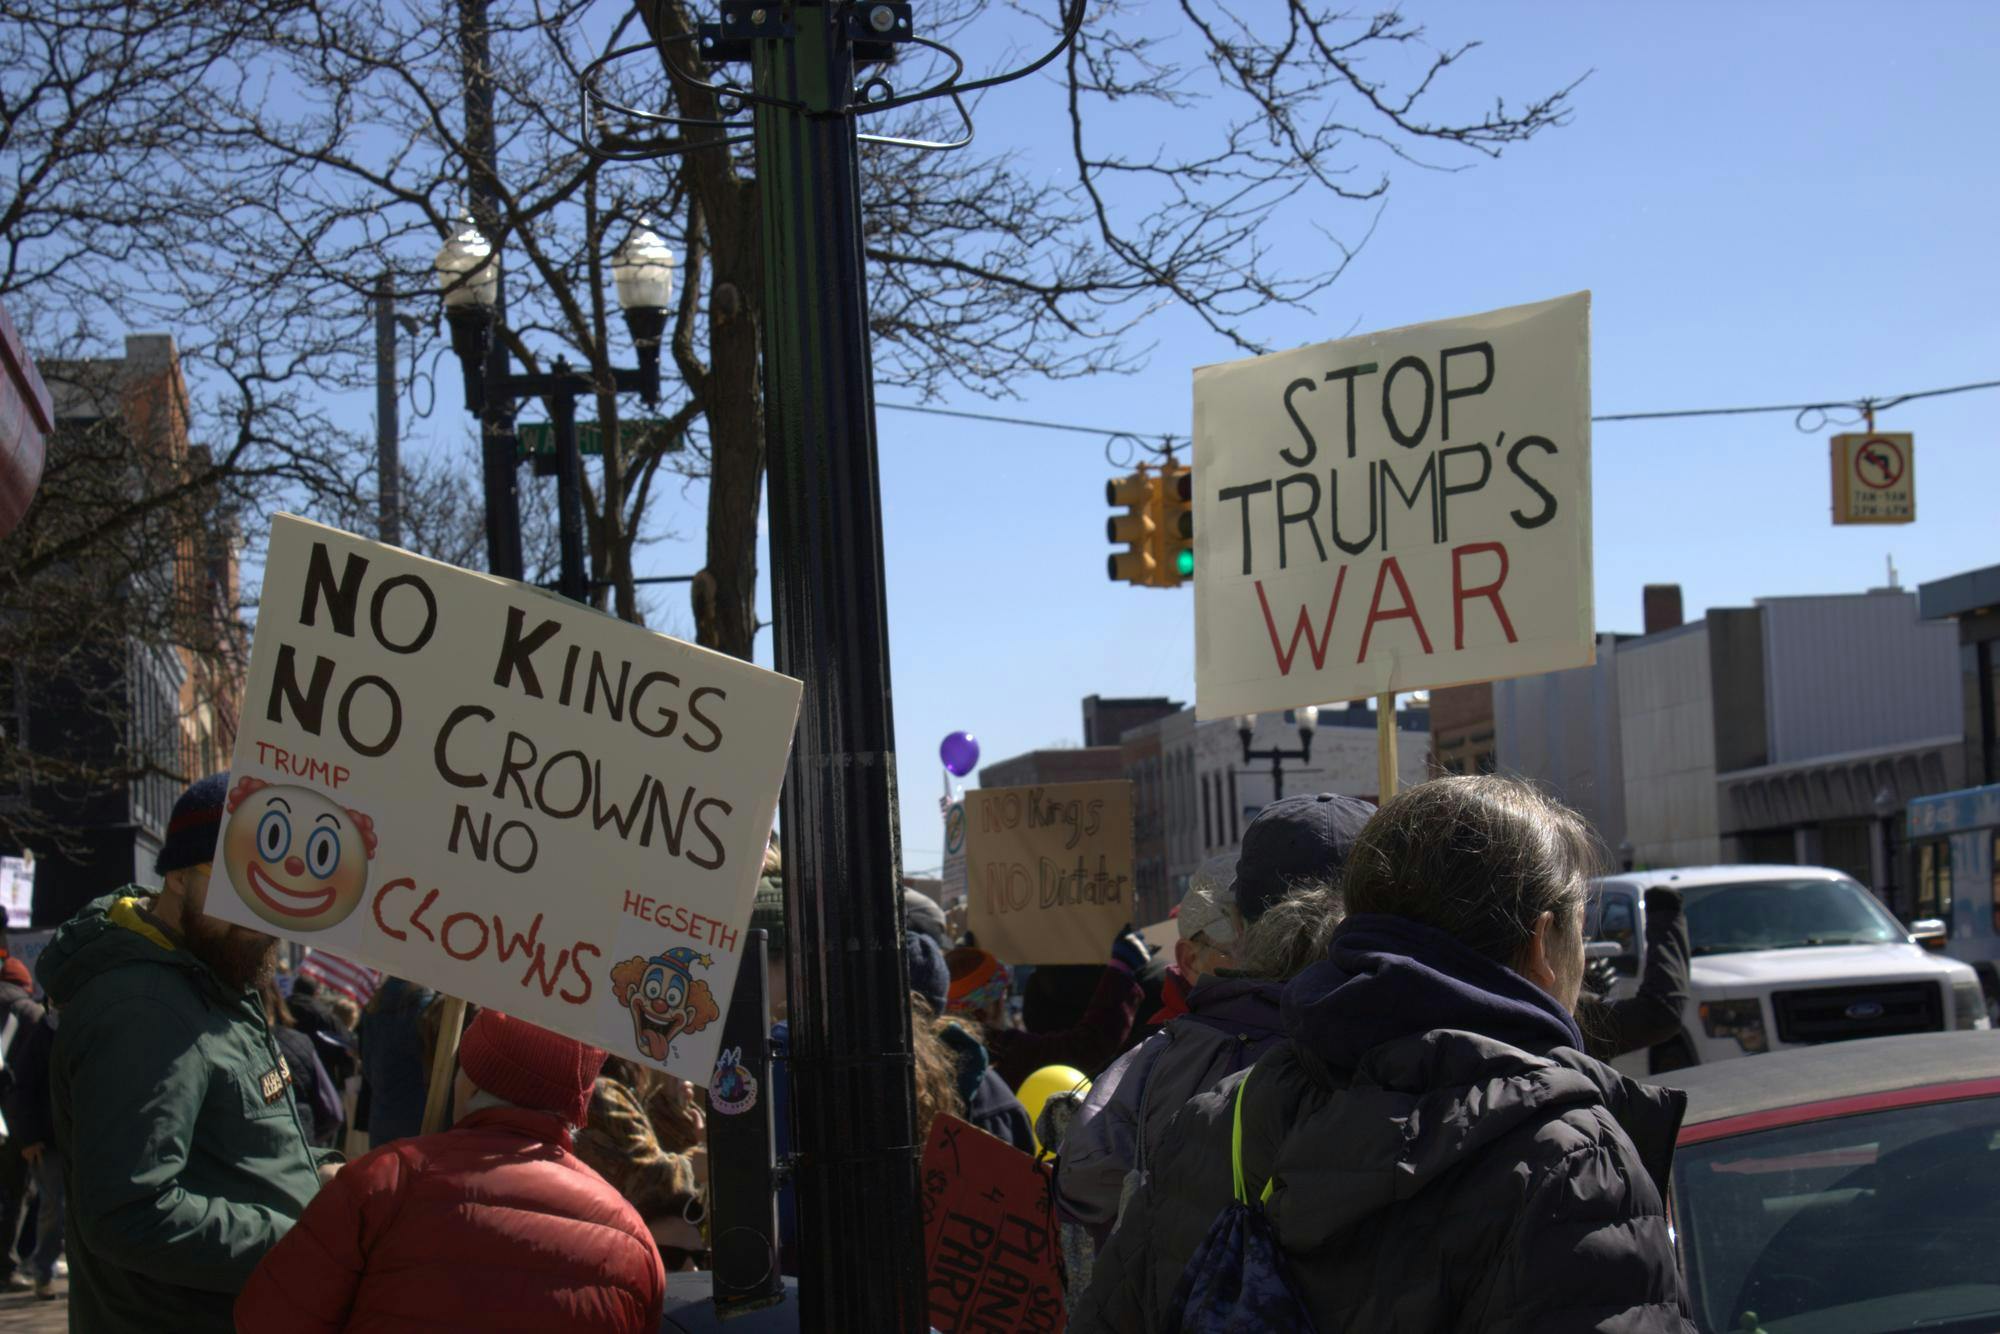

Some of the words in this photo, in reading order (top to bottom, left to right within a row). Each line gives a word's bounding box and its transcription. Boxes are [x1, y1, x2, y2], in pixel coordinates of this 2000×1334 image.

[1279, 341, 1495, 468] STOP
[1218, 431, 1559, 575] TRUMP'S
[299, 542, 438, 654] NO
[493, 605, 727, 753] KINGS
[1255, 541, 1518, 677] WAR
[256, 741, 350, 790] TRUMP
[266, 644, 402, 757] NO
[434, 704, 733, 871] CROWNS
[981, 793, 1021, 833] NO
[1028, 787, 1104, 850] Kings
[448, 804, 538, 874] NO
[985, 862, 1032, 915] NO
[372, 877, 602, 1005] CLOWNS
[624, 889, 739, 954] HEGSETH
